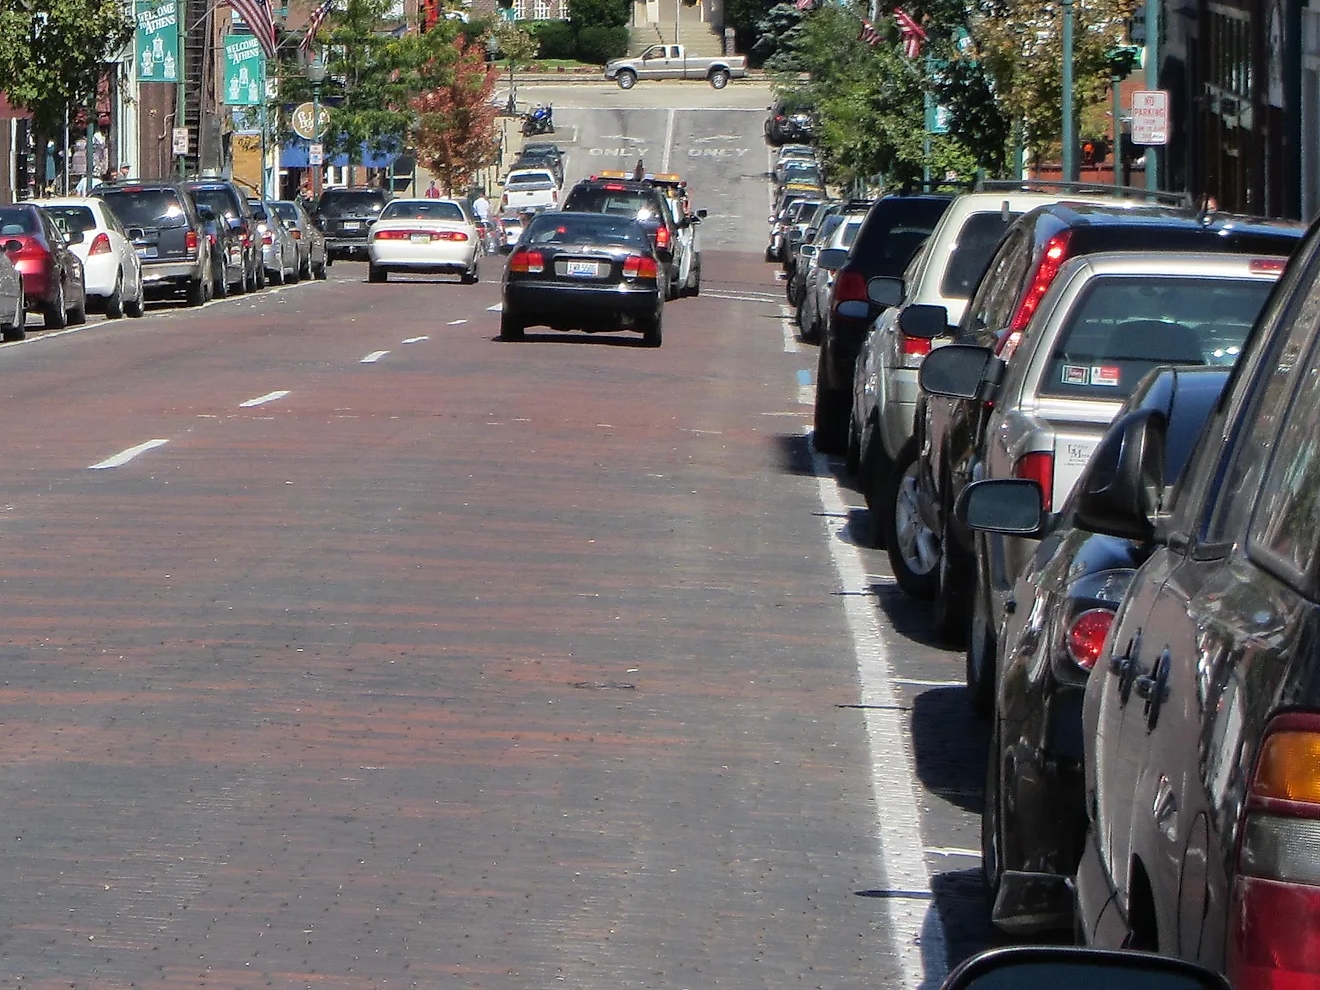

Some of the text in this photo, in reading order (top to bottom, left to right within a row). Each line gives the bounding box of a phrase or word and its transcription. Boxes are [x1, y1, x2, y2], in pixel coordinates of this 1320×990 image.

[137, 3, 175, 22] WELCOME
[145, 14, 176, 35] ATHENS
[226, 38, 259, 53] WELCOME
[232, 48, 259, 65] ATHENS
[1144, 96, 1155, 106] NO
[1134, 108, 1164, 117] PARKING
[588, 148, 649, 157] ONLY
[687, 148, 750, 157] ONLY
